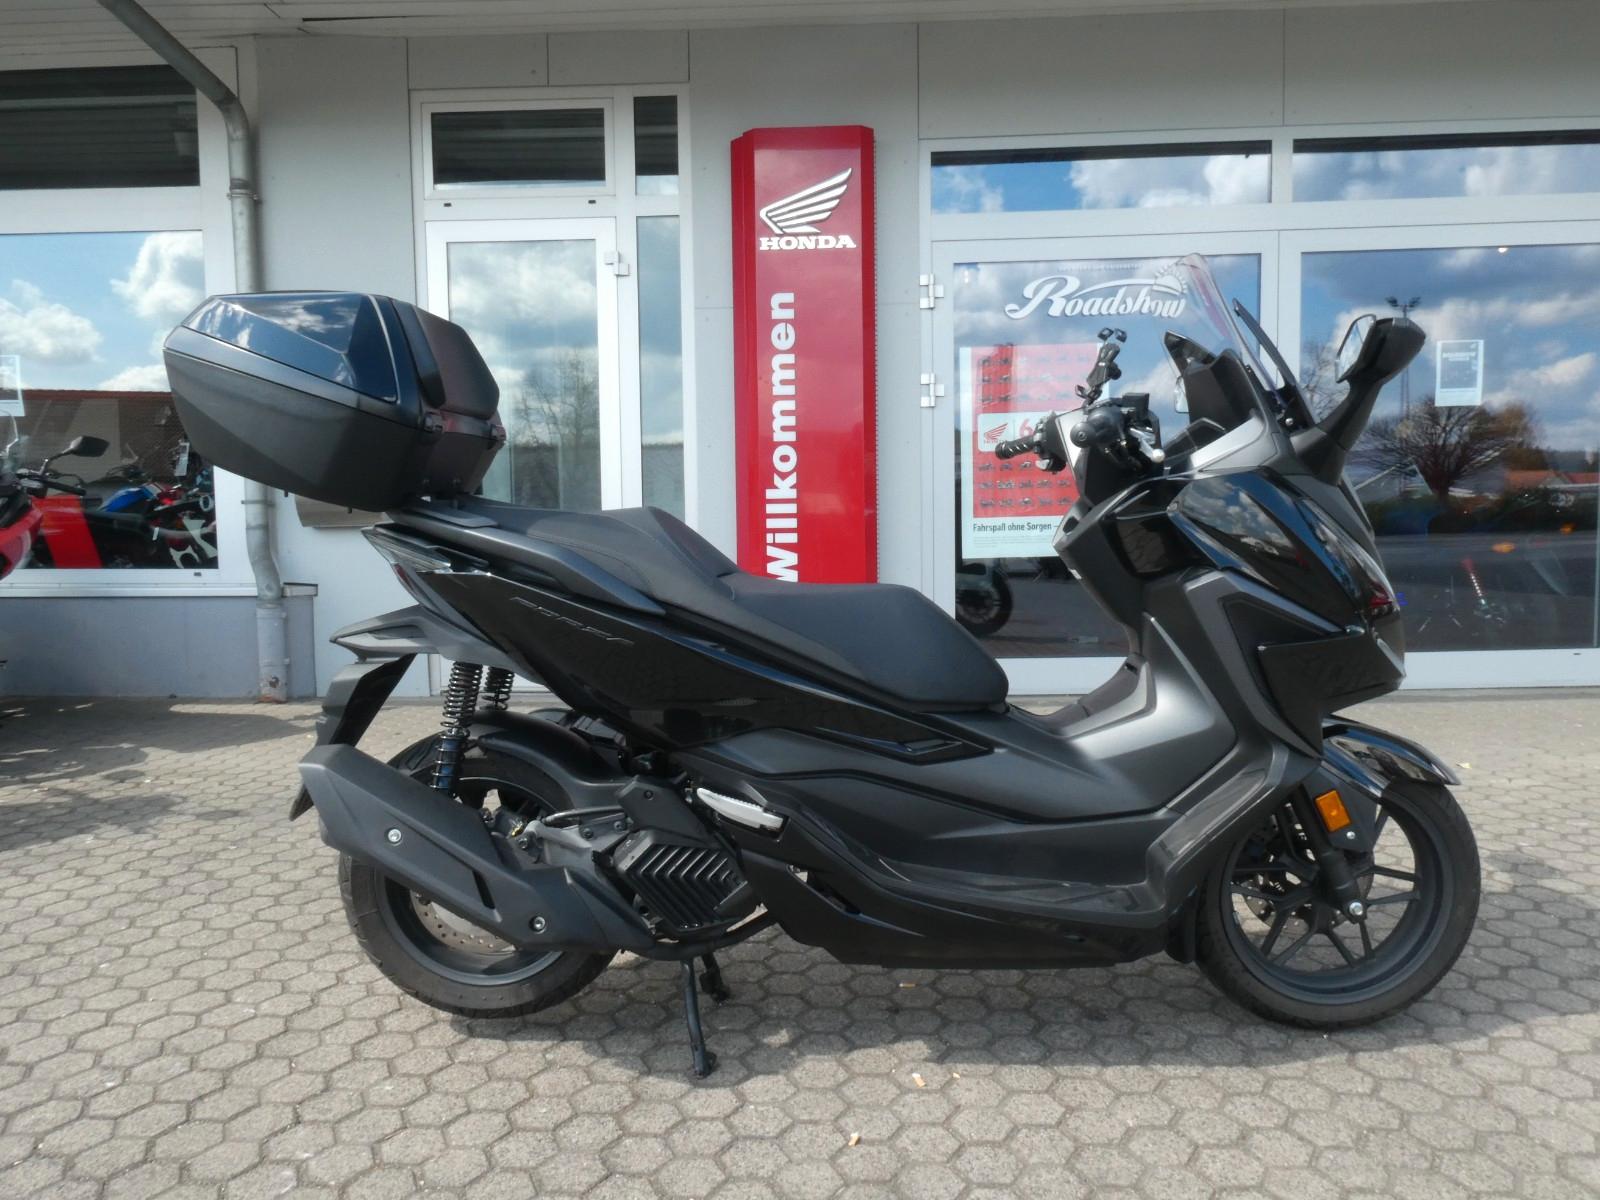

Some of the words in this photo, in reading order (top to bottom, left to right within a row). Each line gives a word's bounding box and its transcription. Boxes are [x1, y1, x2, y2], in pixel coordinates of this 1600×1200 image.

[759, 234, 857, 251] HONDA
[1004, 275, 1187, 320] Roadshow
[765, 292, 799, 583] Willkommen
[1007, 522, 1025, 532] ohne
[1026, 522, 1052, 533] Sorgen
